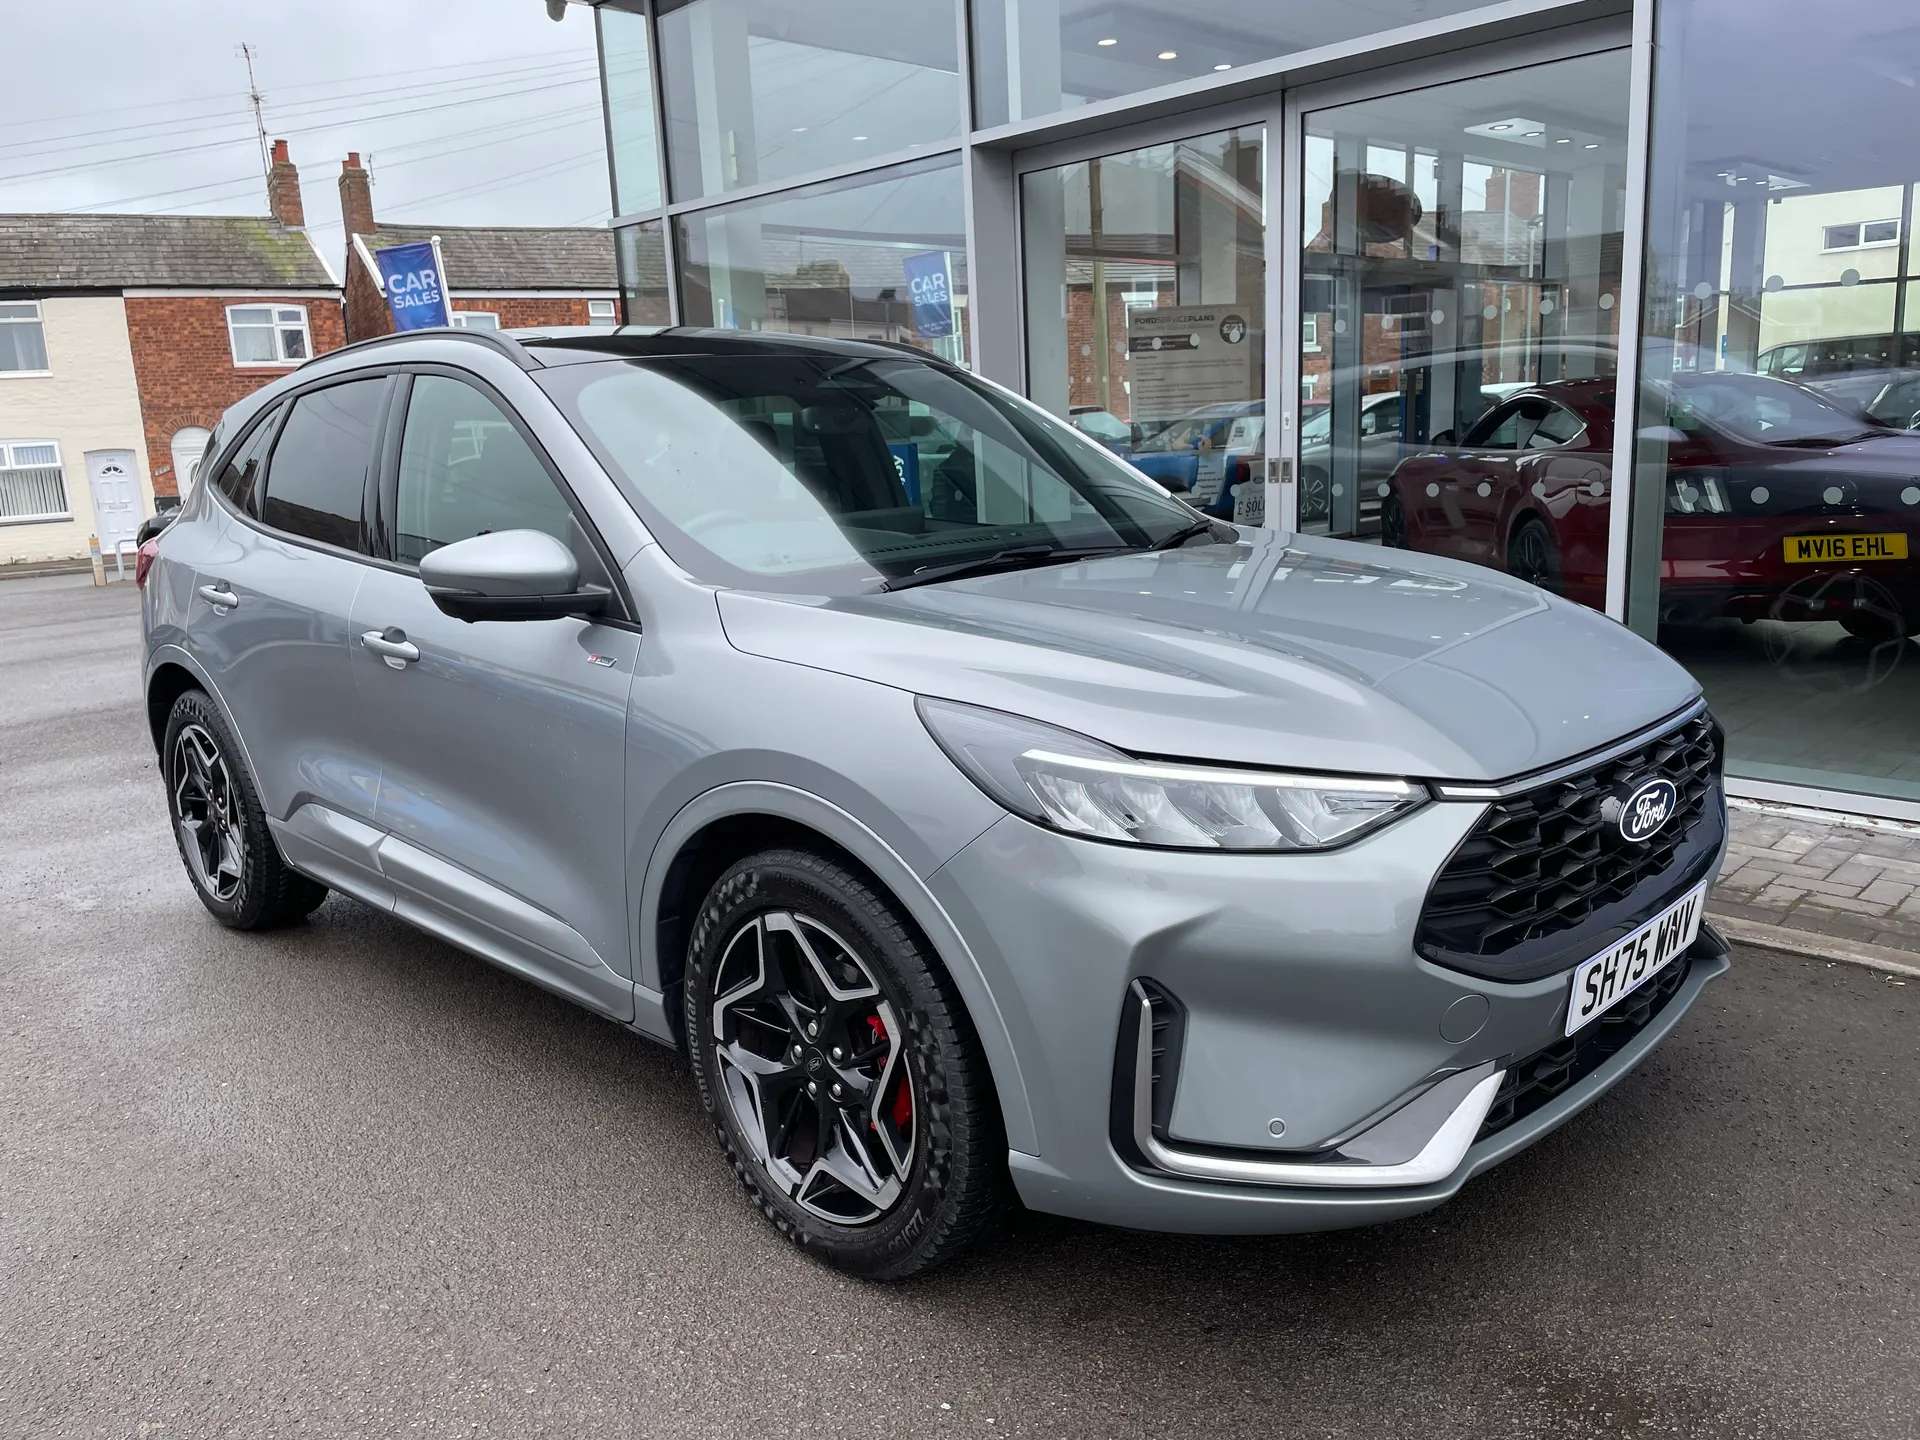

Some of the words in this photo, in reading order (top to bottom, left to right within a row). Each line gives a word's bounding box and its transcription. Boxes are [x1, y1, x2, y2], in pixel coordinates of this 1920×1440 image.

[388, 269, 437, 294] CAR
[911, 272, 945, 294] CAR
[393, 290, 441, 309] SALES
[914, 290, 948, 307] SALES
[1245, 499, 1265, 514] SOL
[1797, 538, 1846, 559] MV16
[1852, 536, 1894, 557] EHL
[1631, 788, 1668, 834] Ford
[1581, 929, 1651, 1017] SH75
[1653, 894, 1698, 967] WNV
